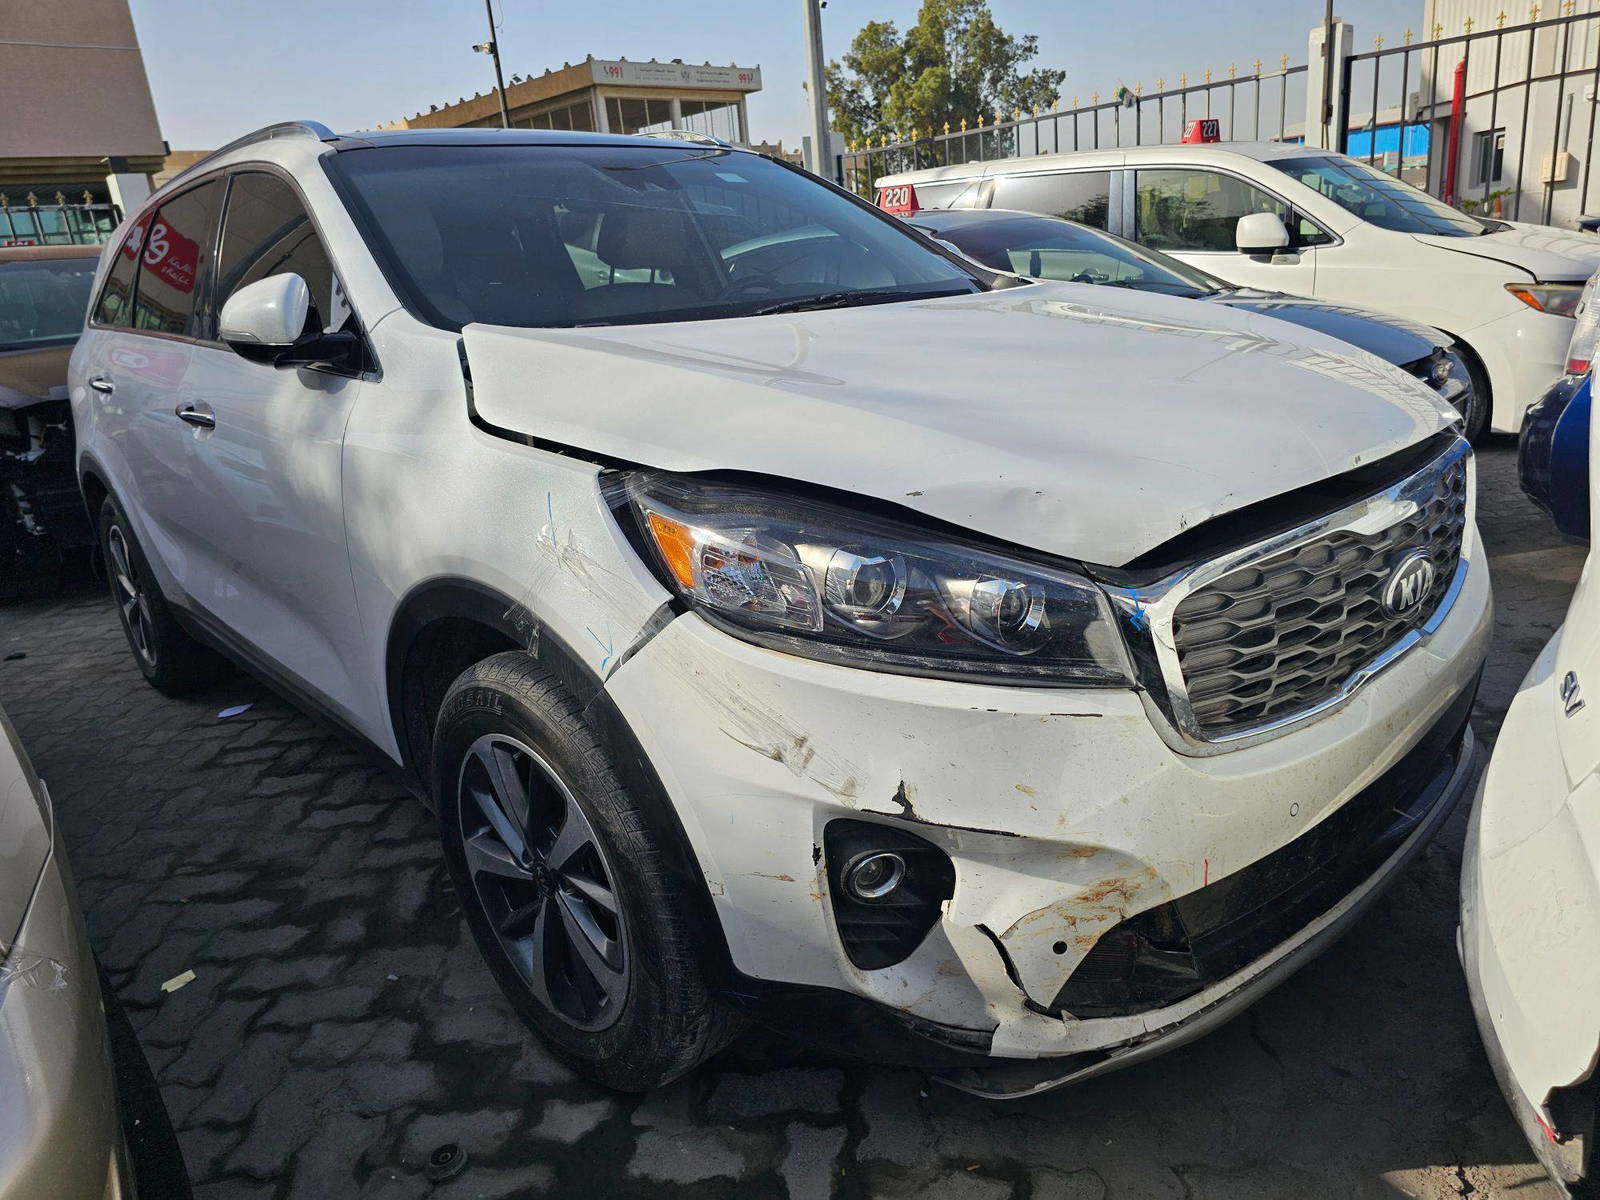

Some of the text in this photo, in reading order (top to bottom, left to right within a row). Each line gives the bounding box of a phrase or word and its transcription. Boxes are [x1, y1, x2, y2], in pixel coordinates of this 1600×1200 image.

[609, 66, 624, 78] 991
[1202, 121, 1218, 138] 227
[885, 187, 909, 208] 220
[1398, 558, 1434, 611] KIA
